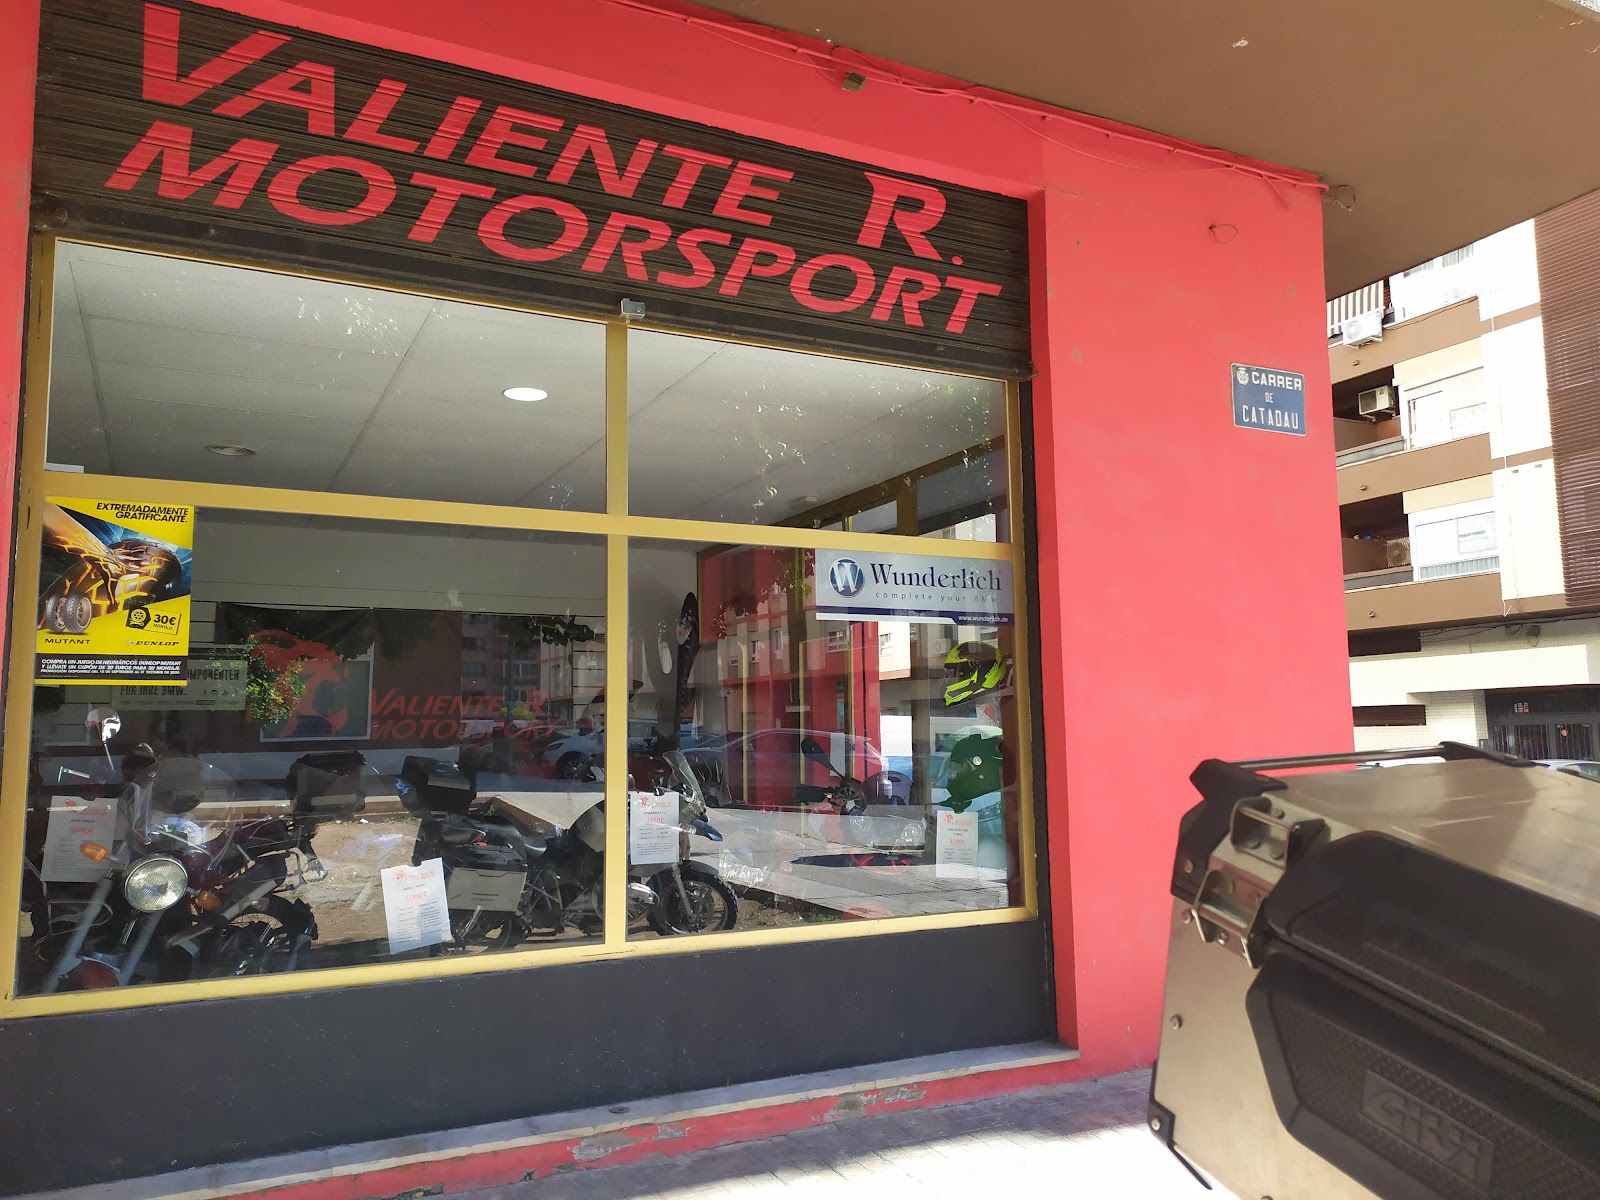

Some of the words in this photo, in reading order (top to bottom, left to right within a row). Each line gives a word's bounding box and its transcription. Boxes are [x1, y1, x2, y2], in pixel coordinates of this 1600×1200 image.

[143, 3, 796, 227] VALIENTE
[857, 171, 965, 266] R.
[104, 119, 1003, 335] MOTORSPORT
[1251, 371, 1302, 391] CARRER
[1264, 392, 1274, 403] DE
[1242, 405, 1299, 430] CATADAU
[96, 502, 189, 516] EXTREMADAMENTE
[115, 511, 188, 523] GRATIFICANTE.
[869, 562, 1003, 591] Wunderlich
[875, 591, 934, 601] complete
[940, 595, 967, 603] your
[153, 613, 177, 626] 30€
[957, 615, 1009, 624] www.wunderlich.de
[45, 637, 91, 646] MUTANT
[371, 687, 505, 716] VALIENTE
